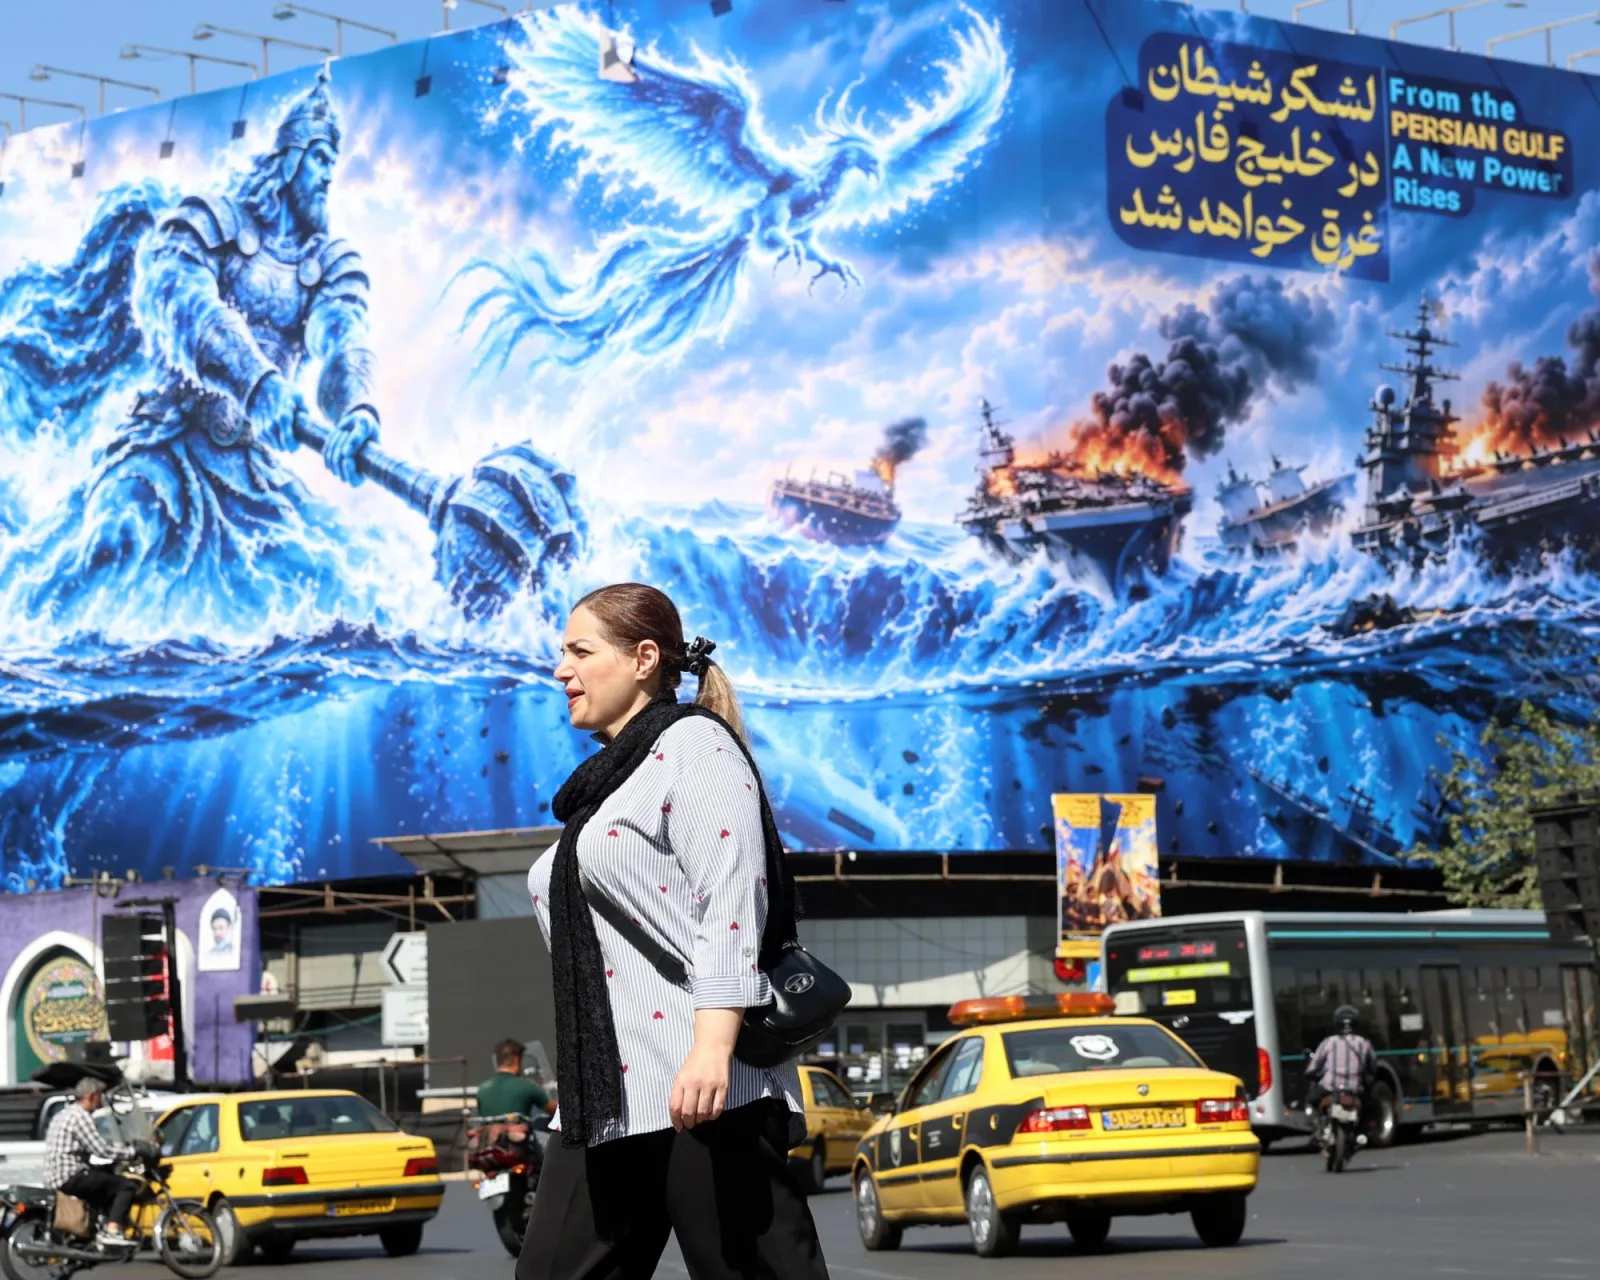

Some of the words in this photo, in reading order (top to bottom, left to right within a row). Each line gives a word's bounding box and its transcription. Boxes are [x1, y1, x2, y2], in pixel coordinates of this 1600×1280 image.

[1148, 42, 1273, 112] شیطان
[1270, 63, 1377, 123] لشکر
[1389, 77, 1461, 114] From
[1470, 90, 1516, 122] the
[1126, 109, 1230, 173] فارس
[1235, 125, 1335, 187] خلیج
[1391, 110, 1498, 152] PERSIAN
[1502, 127, 1565, 161] GULF
[1337, 151, 1381, 198] در
[1392, 143, 1413, 172] A
[1420, 146, 1476, 181] New
[1483, 155, 1563, 193] Power
[1393, 176, 1461, 212] Rises
[1119, 184, 1183, 230] شد
[1188, 190, 1305, 258] خواهد
[1311, 207, 1381, 269] غرق
